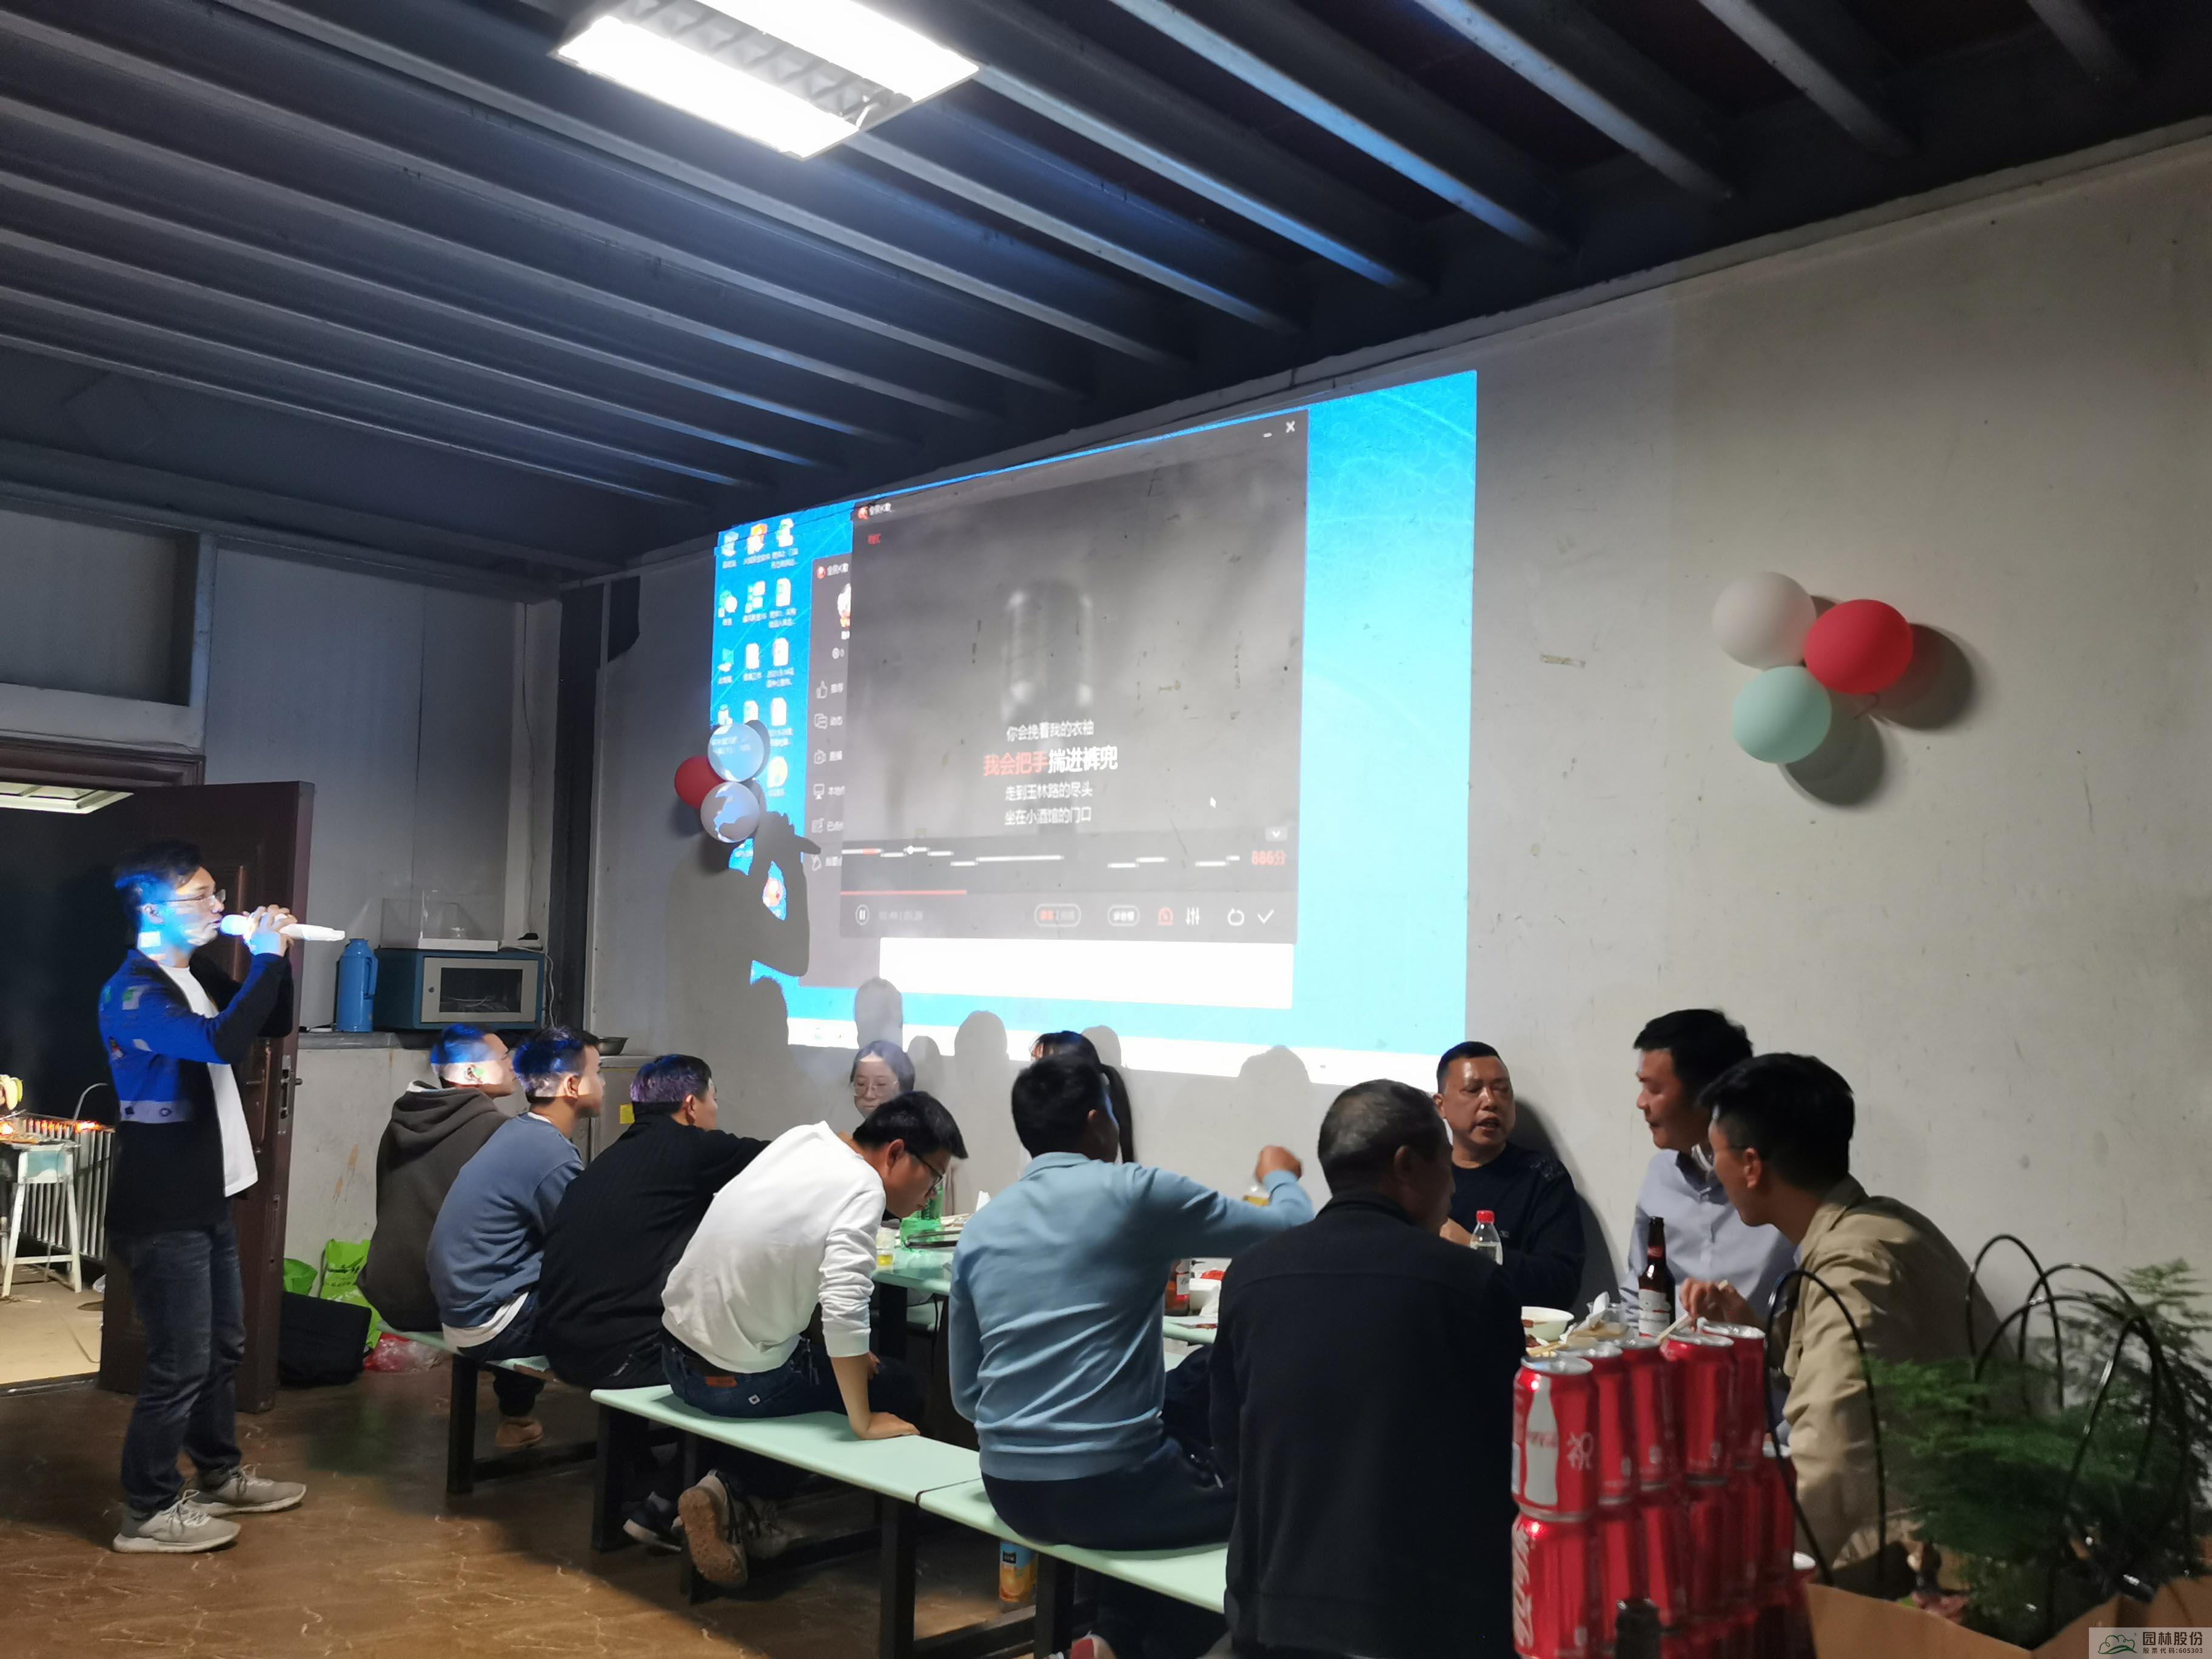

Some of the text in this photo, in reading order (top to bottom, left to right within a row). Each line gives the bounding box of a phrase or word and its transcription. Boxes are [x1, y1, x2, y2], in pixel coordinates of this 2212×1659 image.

[1006, 719, 1094, 742] 你会挽着我的衣袖
[984, 745, 1119, 777] 我会把手揣进裤兜
[1005, 781, 1093, 801] 走到玉林路的尽头
[1004, 806, 1092, 825] 坐在小酒馆的门口
